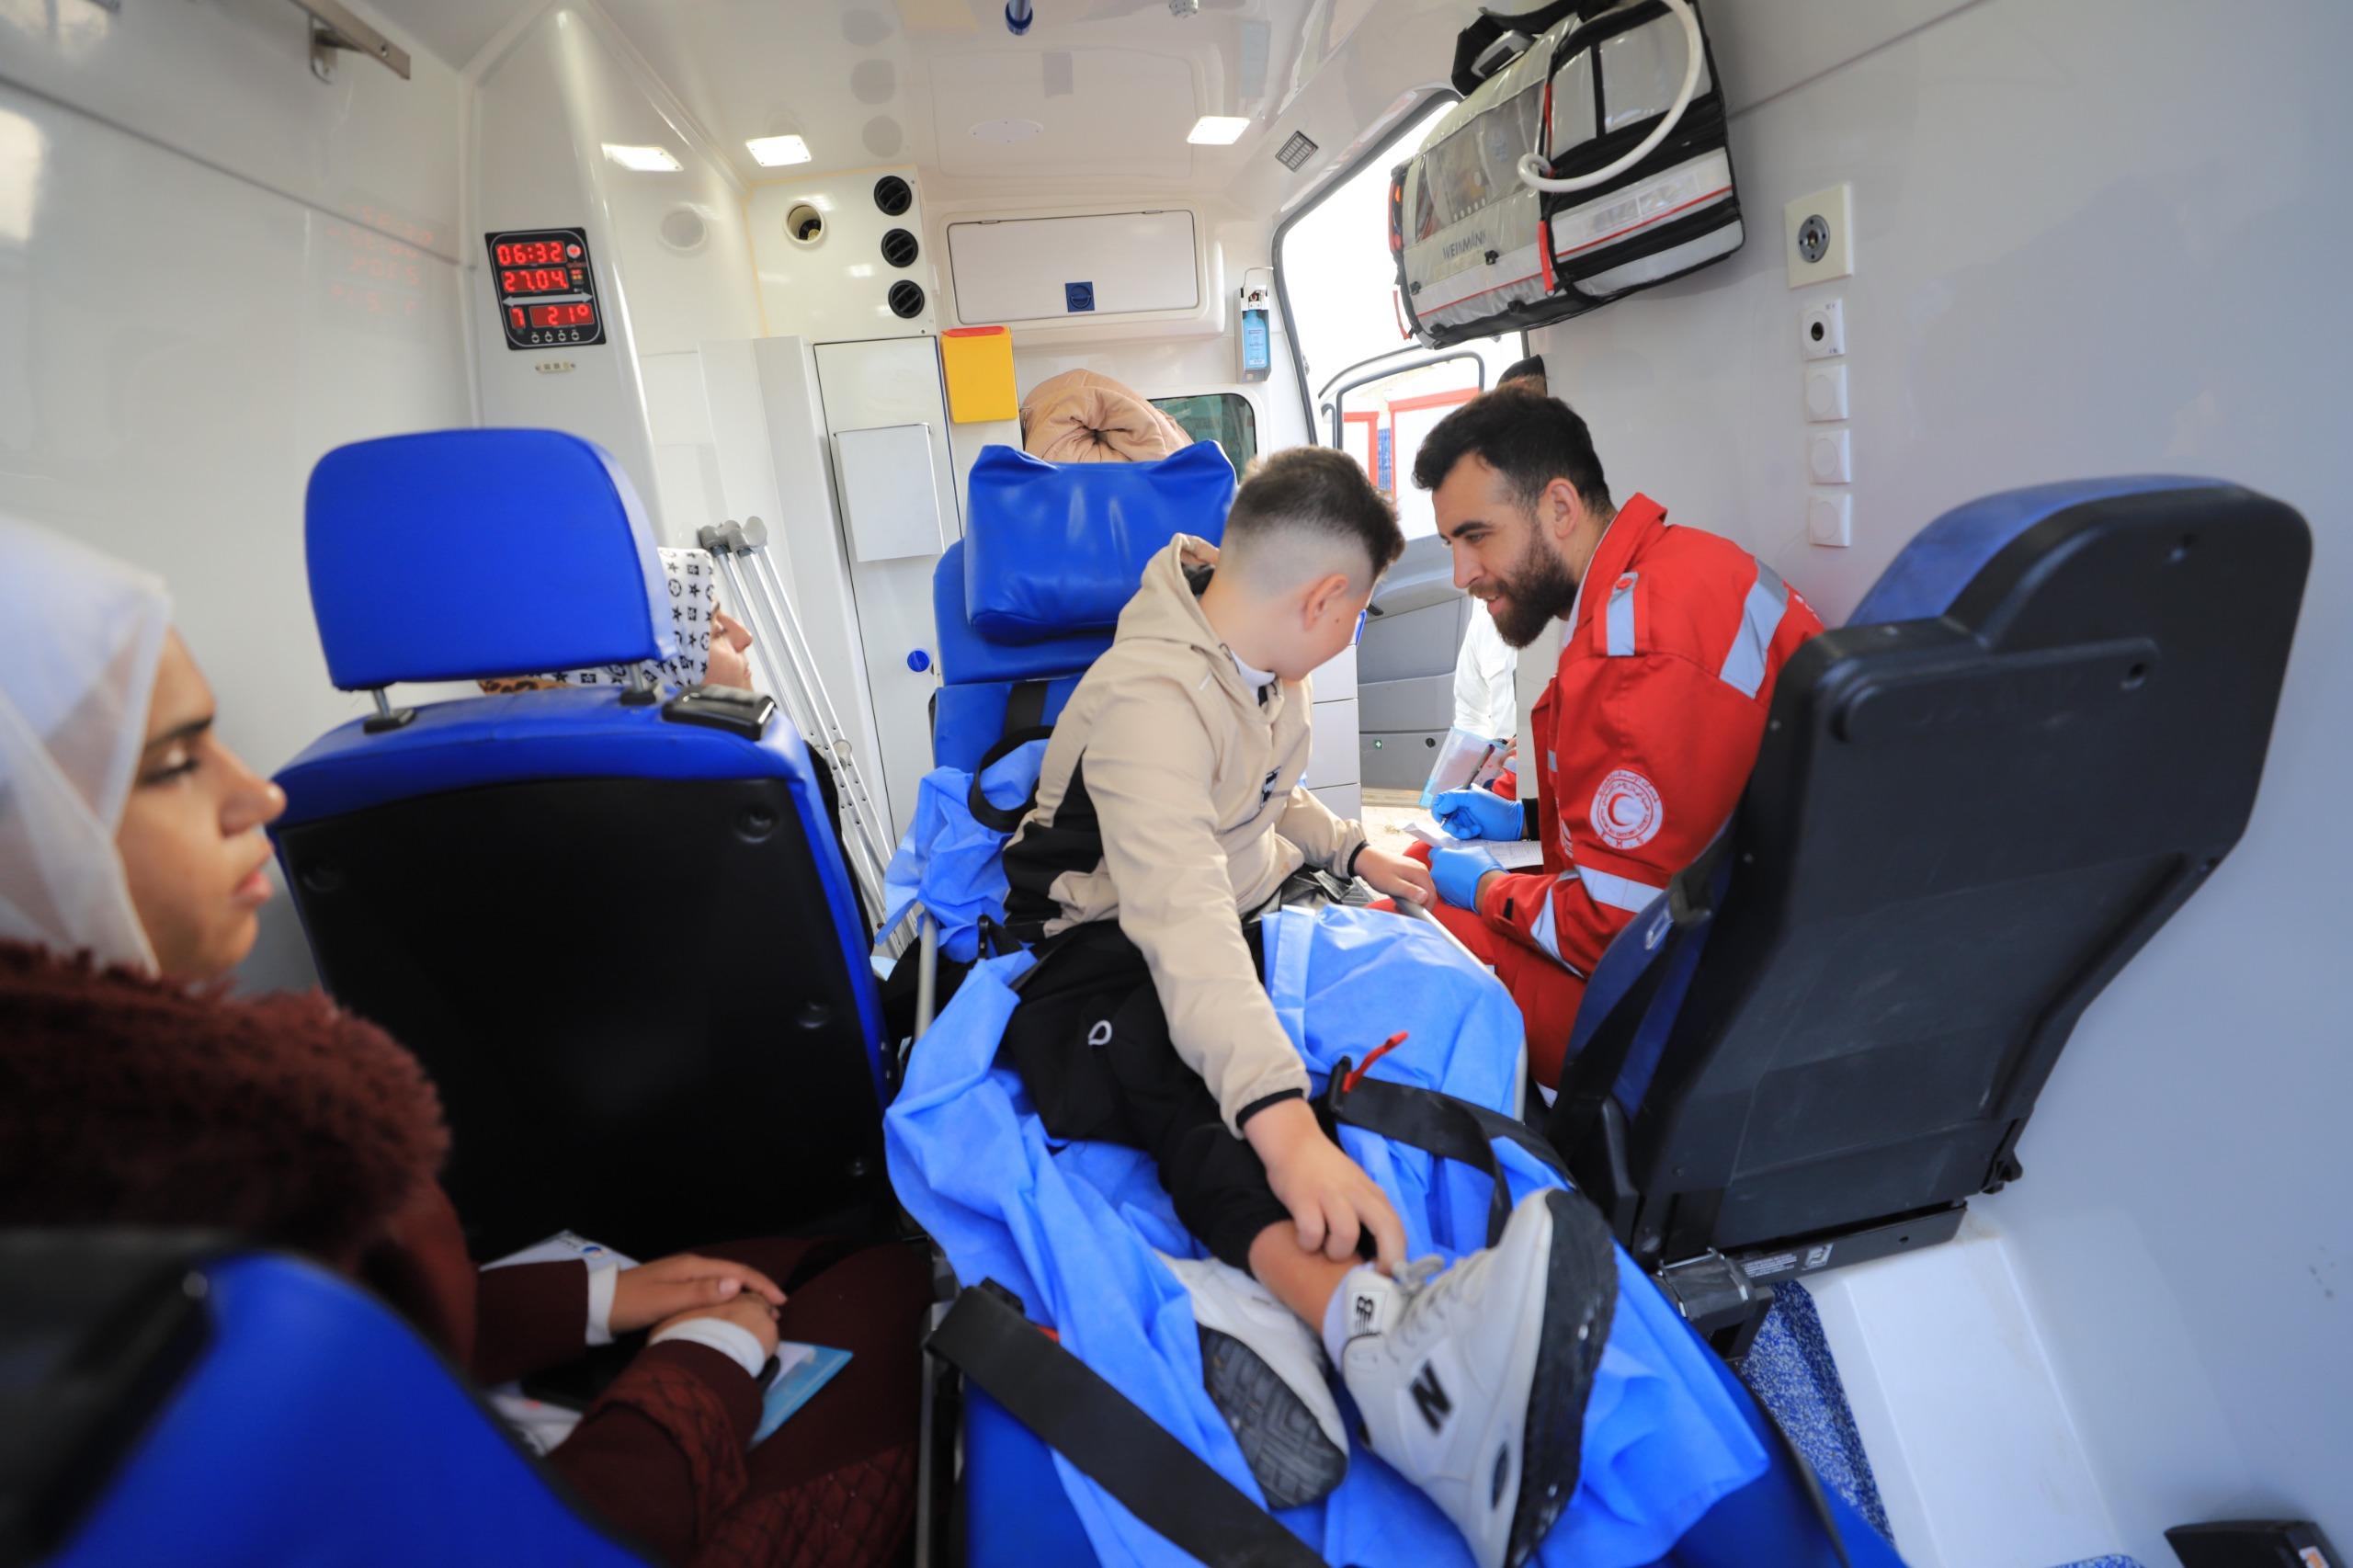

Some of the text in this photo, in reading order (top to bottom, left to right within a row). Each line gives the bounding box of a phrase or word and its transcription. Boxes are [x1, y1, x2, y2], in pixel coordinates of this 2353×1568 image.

[497, 243, 563, 265] 06:32
[512, 309, 525, 328] 7
[1411, 1359, 1452, 1435] N
